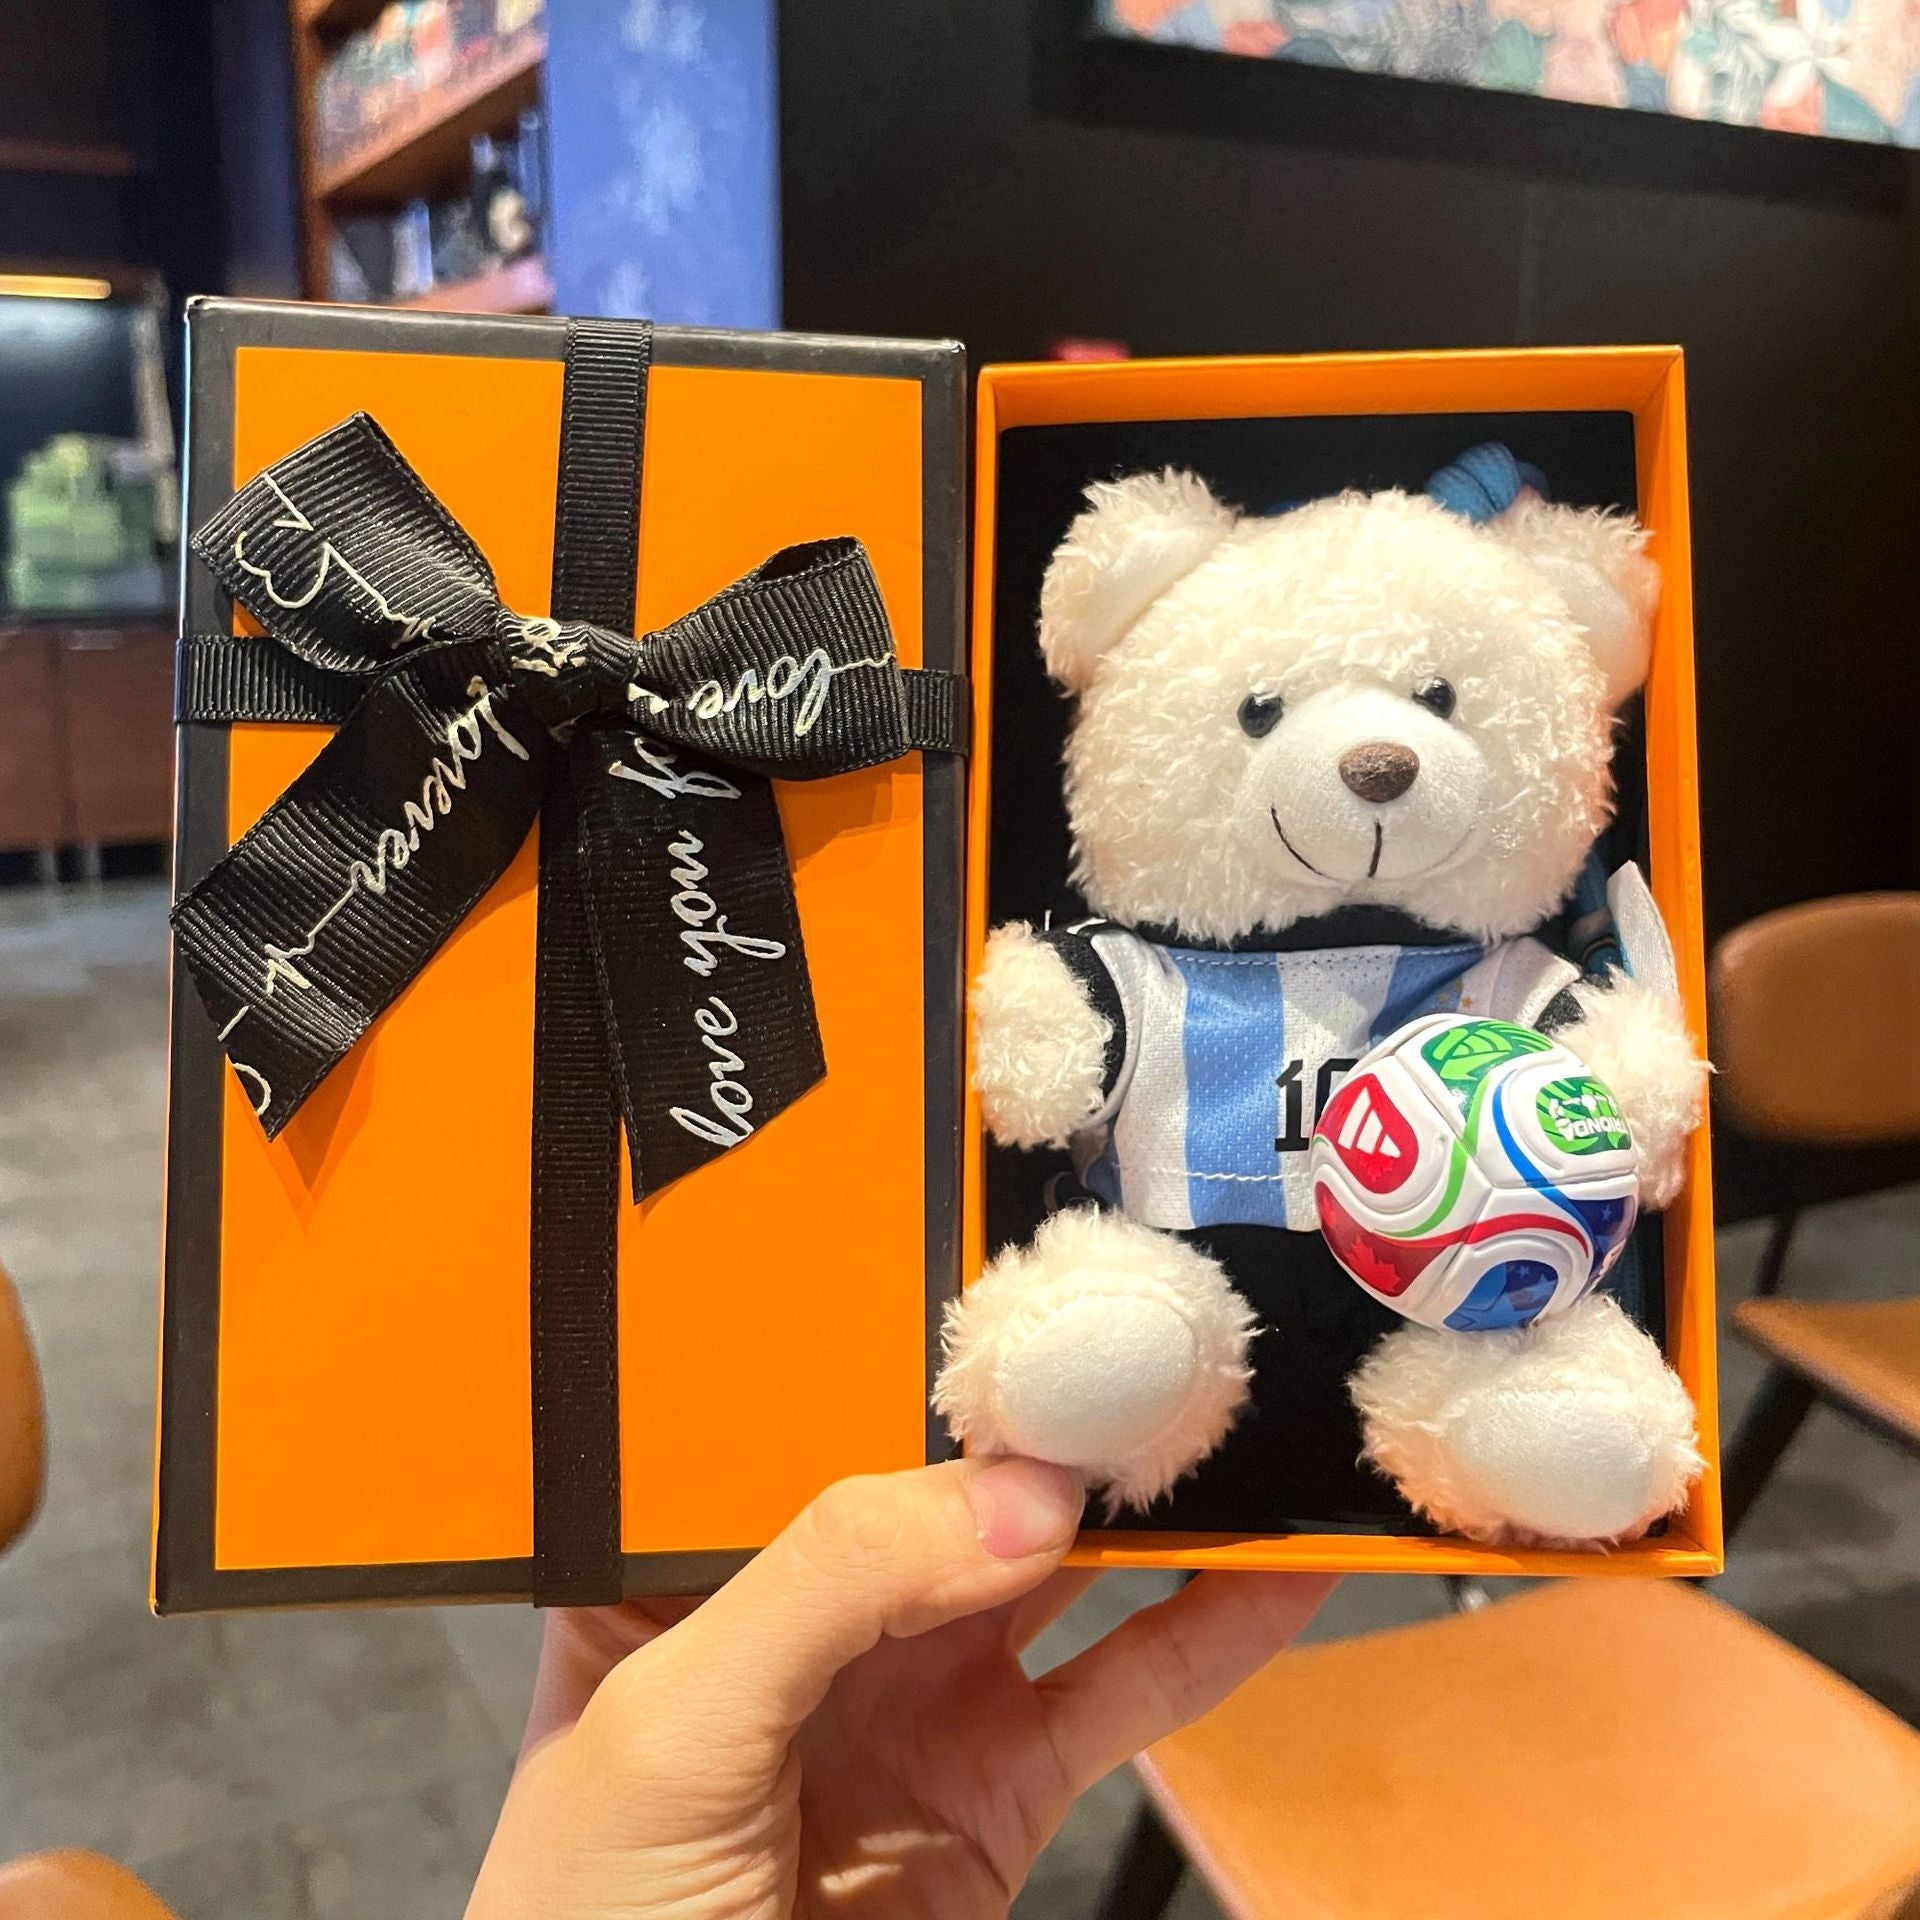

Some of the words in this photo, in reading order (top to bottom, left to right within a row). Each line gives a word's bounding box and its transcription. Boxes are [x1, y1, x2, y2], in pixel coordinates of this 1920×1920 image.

[687, 648, 832, 737] love
[351, 676, 530, 894] forever
[667, 829, 787, 977] you
[668, 996, 756, 1148] love
